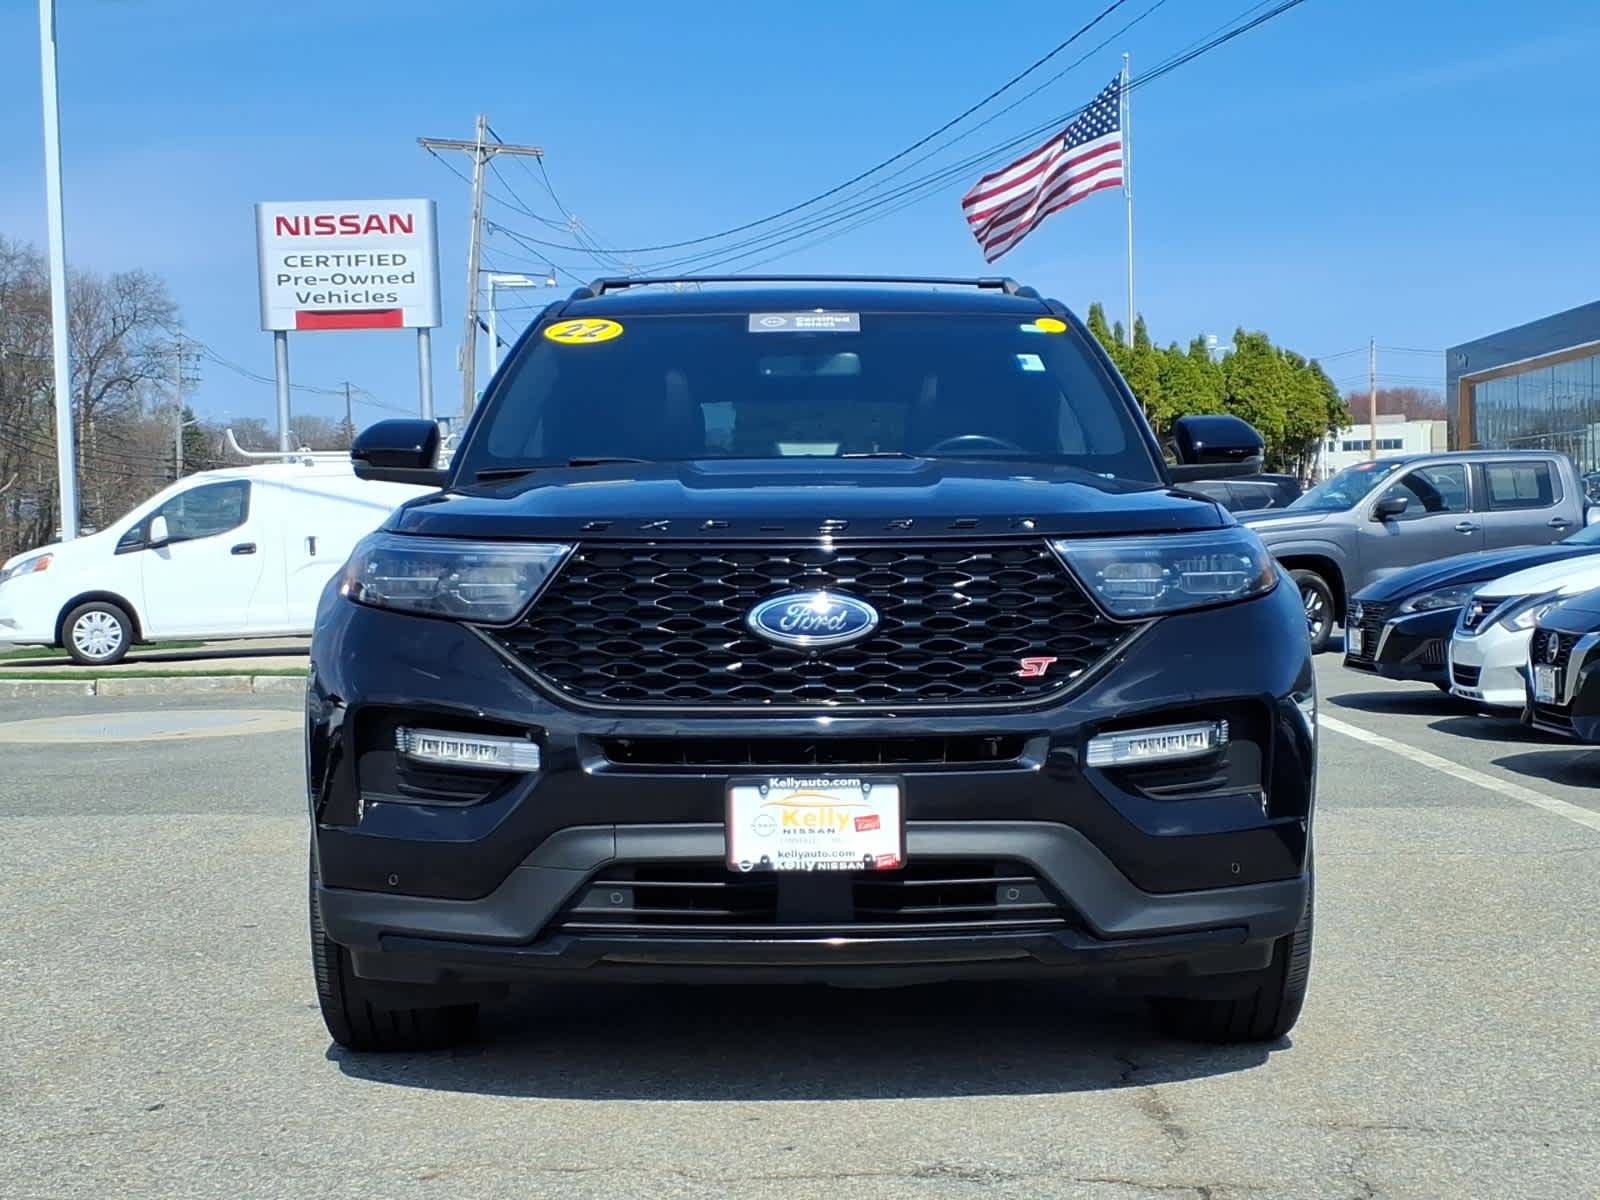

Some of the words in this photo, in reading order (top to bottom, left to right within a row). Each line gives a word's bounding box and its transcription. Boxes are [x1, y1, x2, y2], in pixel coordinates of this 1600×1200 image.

[275, 214, 414, 236] NISSAN
[283, 254, 407, 268] CERTIFIED
[277, 271, 415, 286] Pre-Owned
[295, 290, 398, 304] Vehicles
[553, 323, 611, 338] 22
[780, 601, 848, 631] Ford
[1019, 656, 1058, 677] ST
[769, 777, 861, 788] Kellyauto.com
[782, 808, 852, 832] Kelly
[777, 850, 856, 860] kellyauto.com
[773, 860, 817, 872] Kelly
[817, 861, 866, 870] NISSAN
